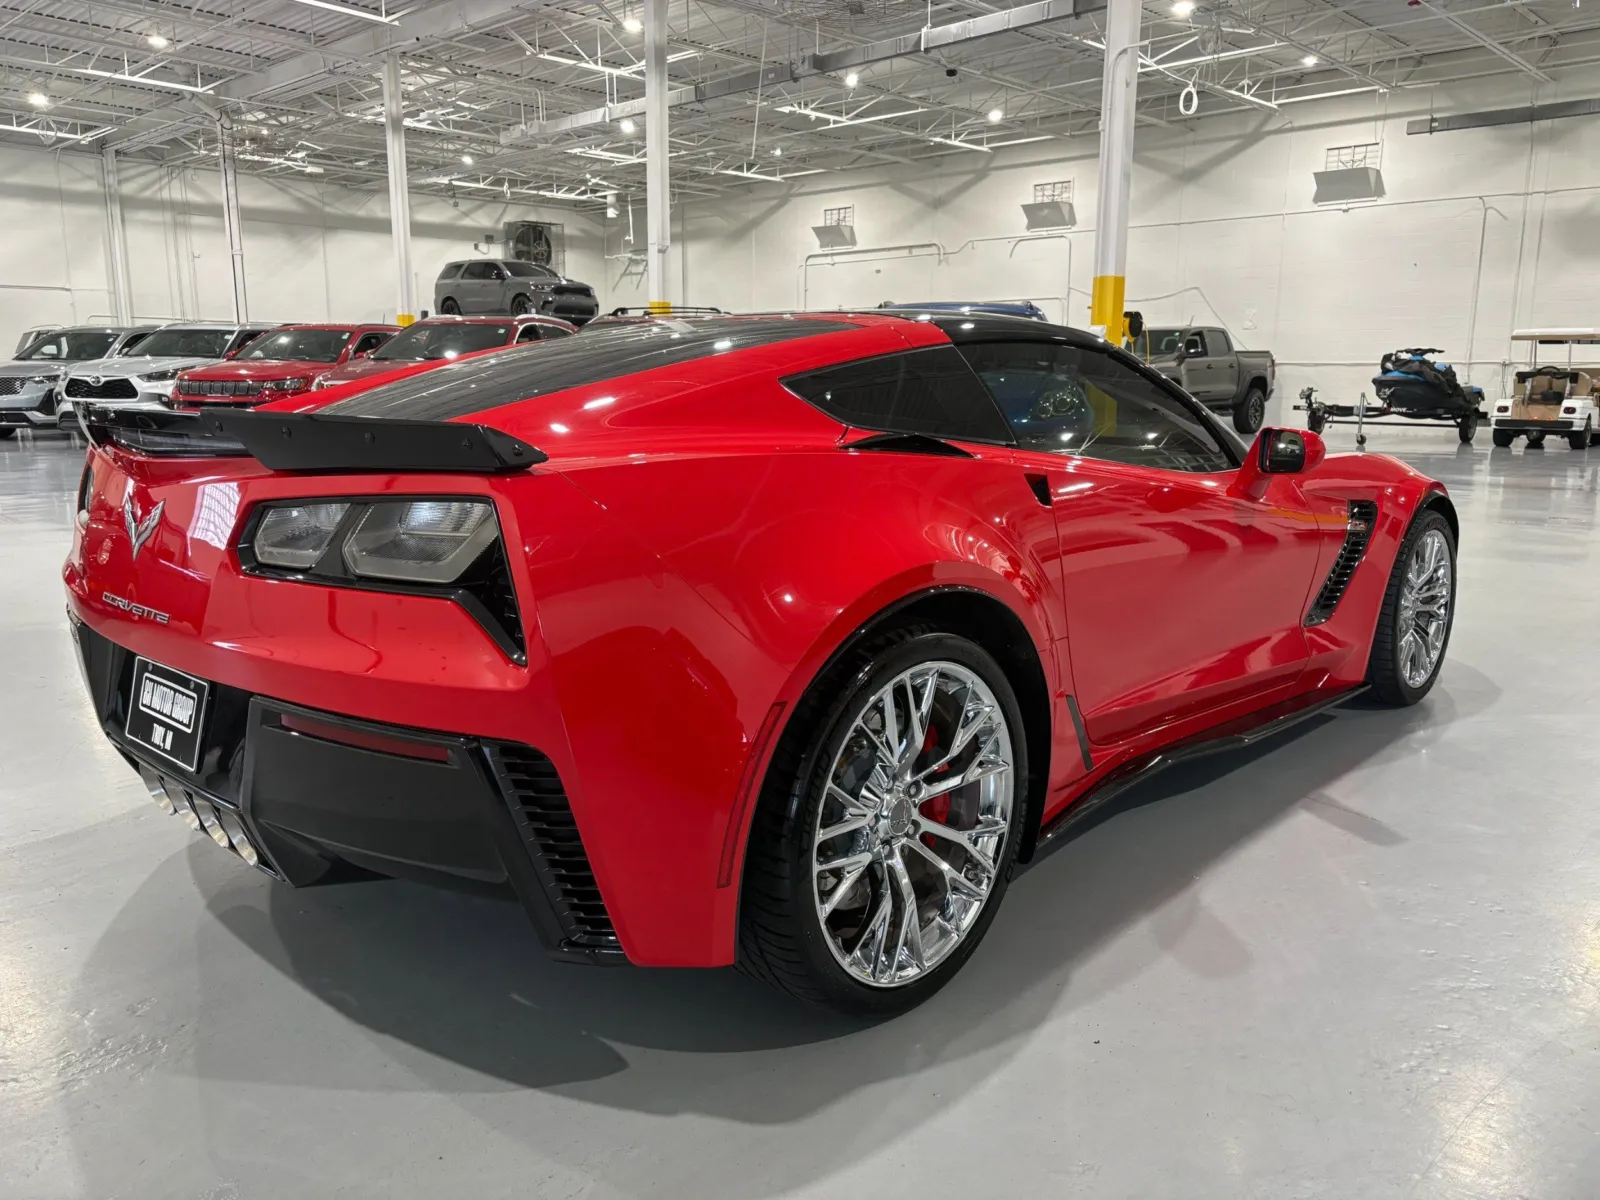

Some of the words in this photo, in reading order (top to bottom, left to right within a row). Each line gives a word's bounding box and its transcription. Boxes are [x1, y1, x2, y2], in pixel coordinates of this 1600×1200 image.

[102, 592, 169, 624] CORVETTE
[150, 682, 175, 717] MOTOR
[171, 692, 194, 725] GROUP
